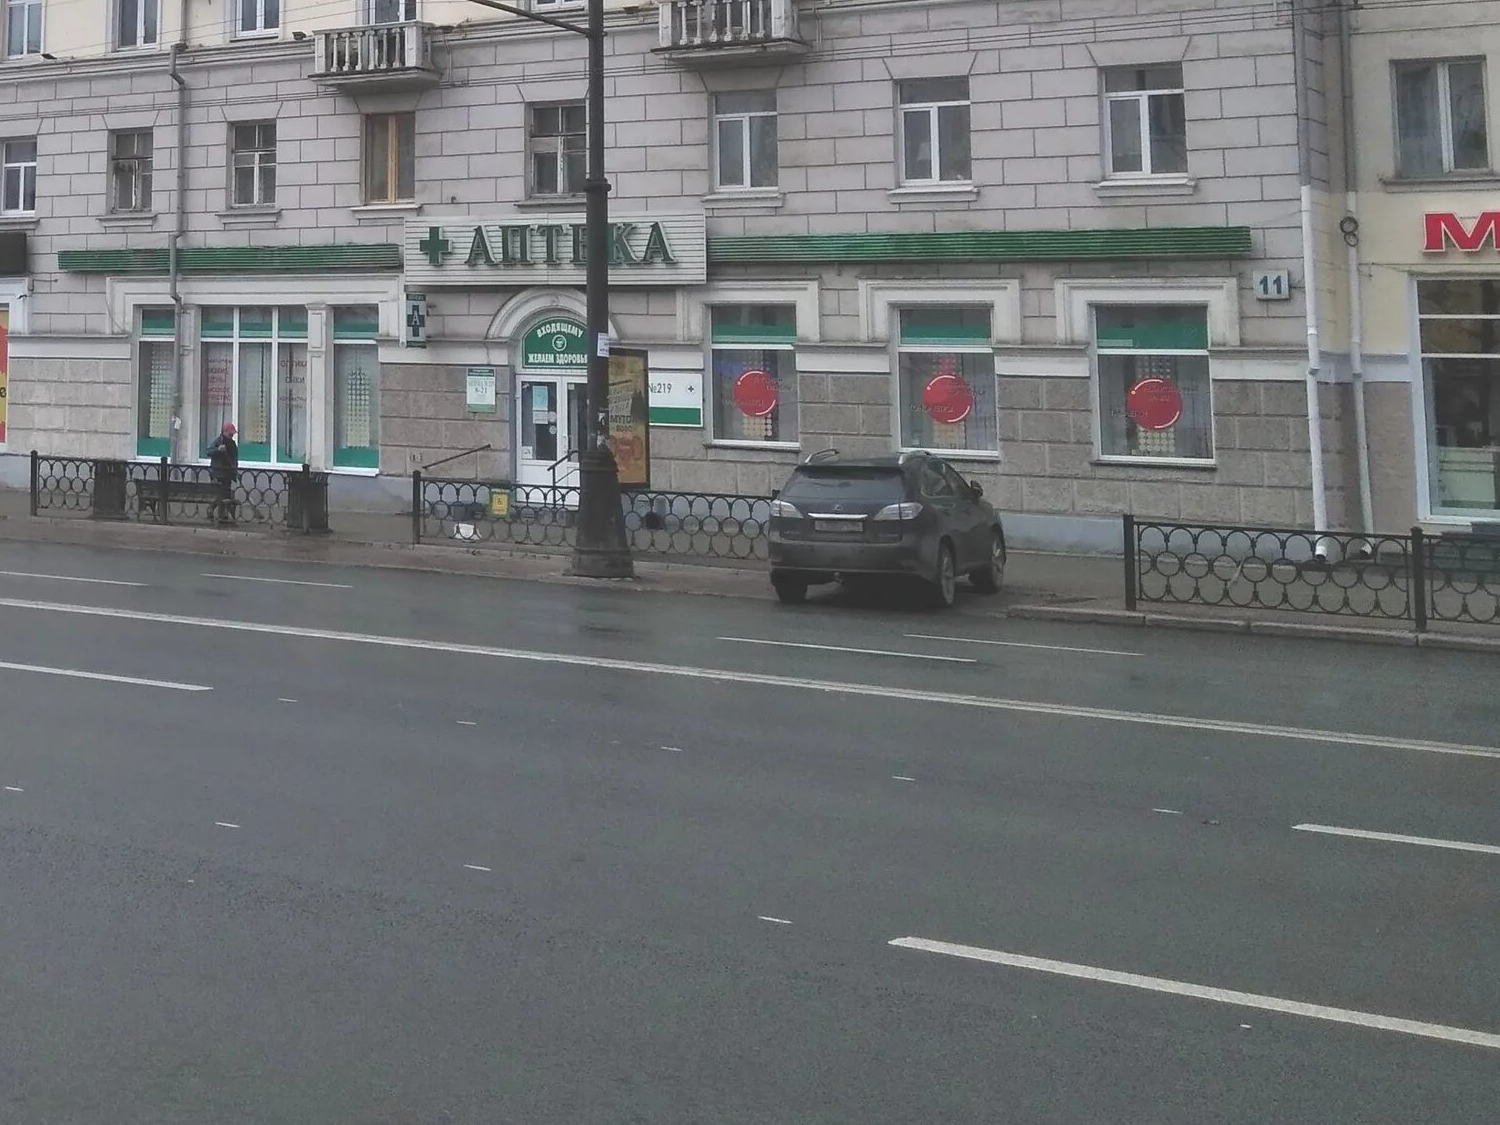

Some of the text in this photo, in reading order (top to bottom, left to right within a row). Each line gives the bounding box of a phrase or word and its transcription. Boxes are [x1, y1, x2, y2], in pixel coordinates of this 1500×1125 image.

[1258, 275, 1282, 295] 11
[536, 322, 584, 338] ВХОДЯЩЕМУ
[528, 353, 555, 364] ЖЕЛАЕМ
